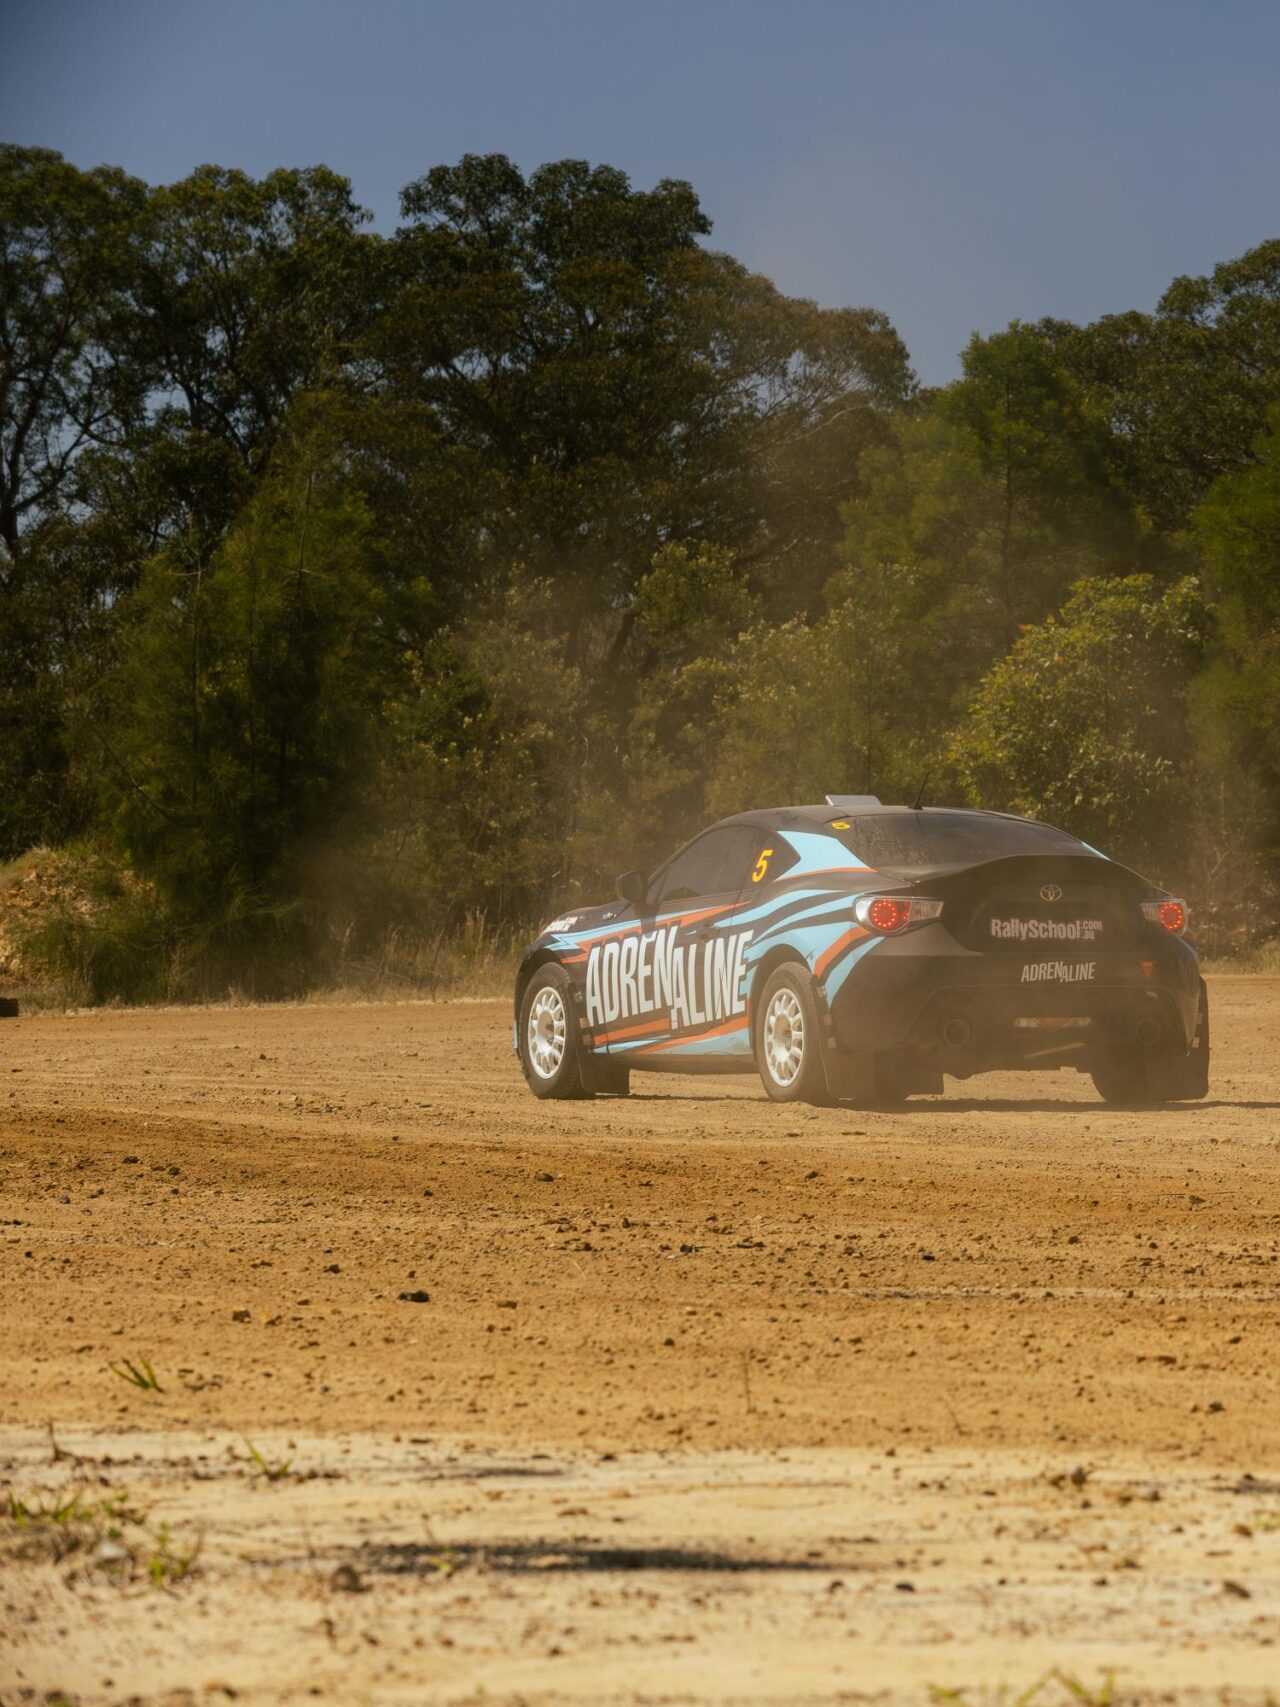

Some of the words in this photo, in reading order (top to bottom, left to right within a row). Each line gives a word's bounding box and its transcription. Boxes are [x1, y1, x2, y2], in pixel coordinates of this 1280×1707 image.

[752, 849, 774, 882] 5
[586, 925, 754, 1030] ADRENALINE
[1021, 961, 1096, 983] ADRENALINE
